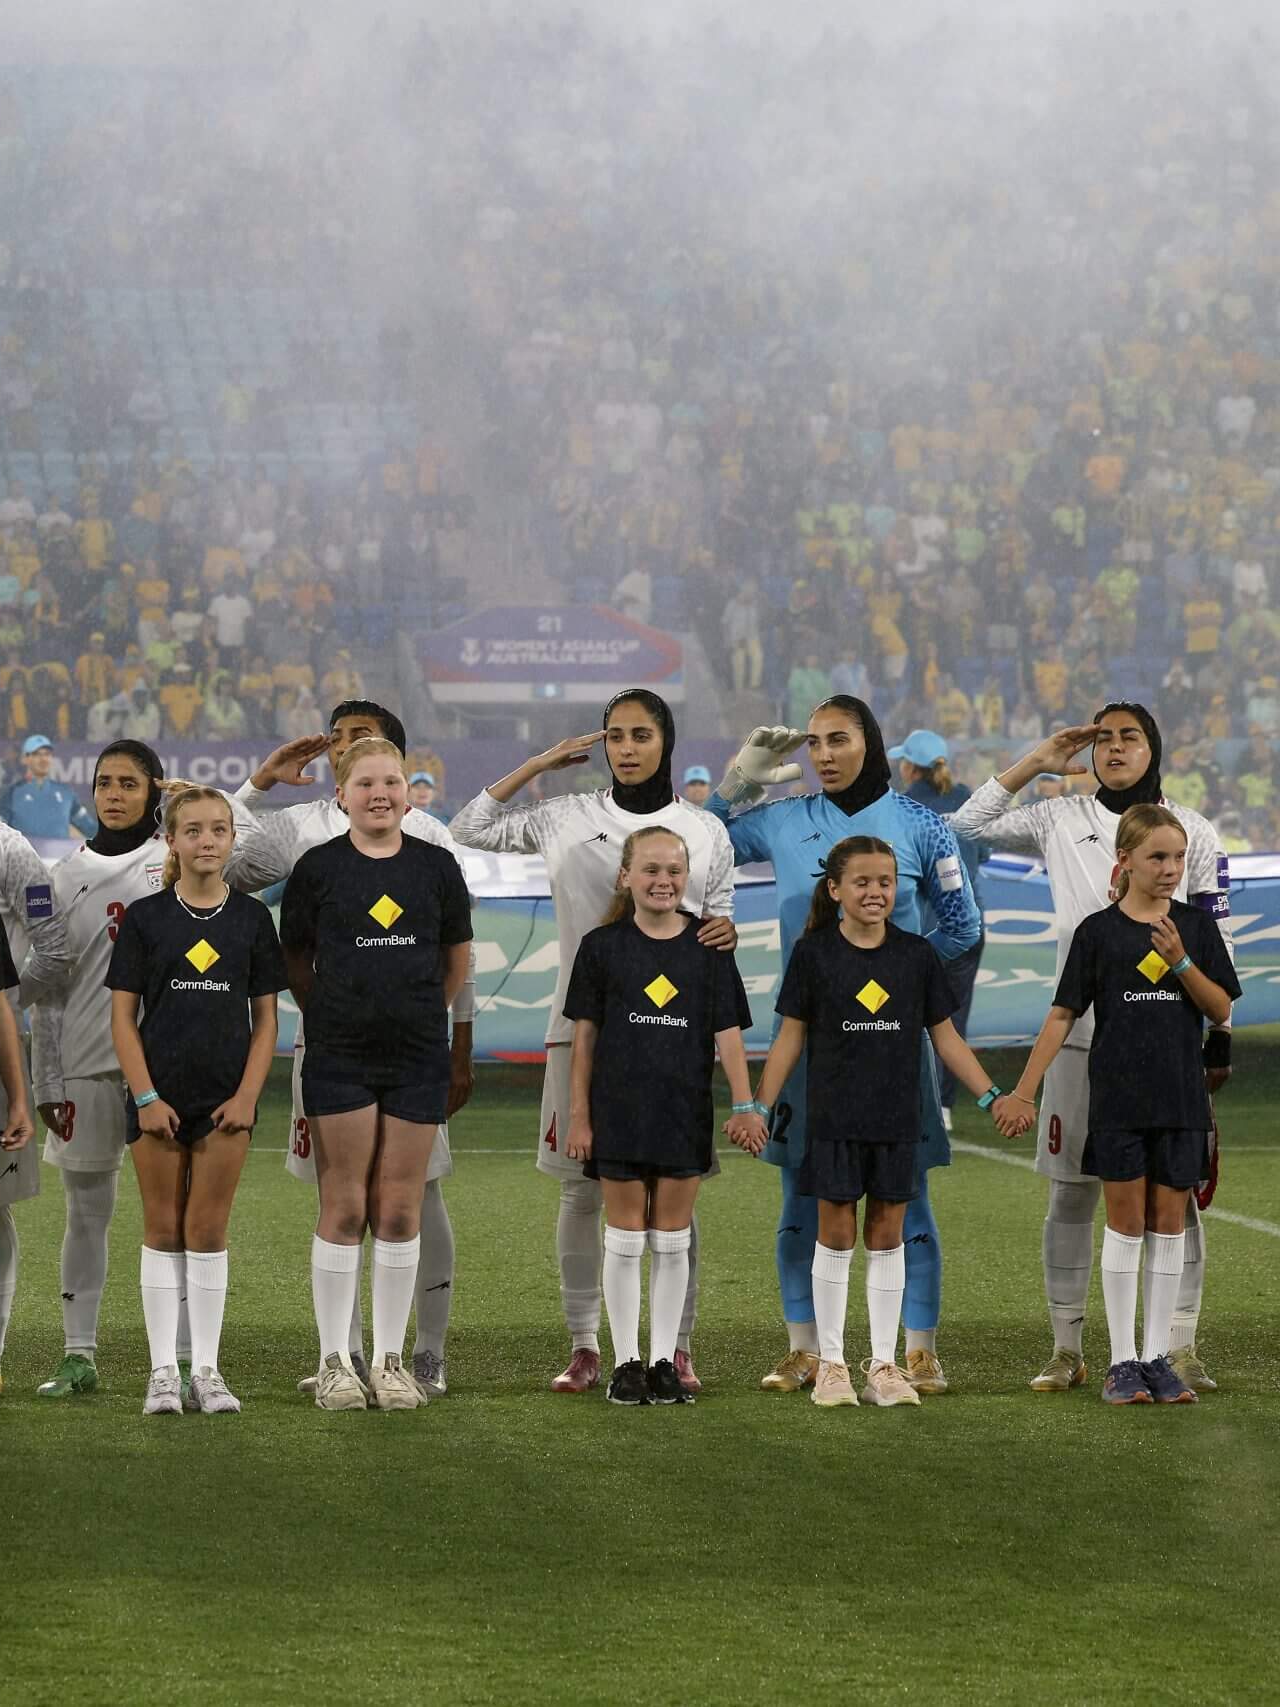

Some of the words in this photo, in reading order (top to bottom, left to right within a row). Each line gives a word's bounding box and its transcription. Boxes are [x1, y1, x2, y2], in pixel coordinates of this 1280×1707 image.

[537, 615, 562, 632] 21
[486, 653, 576, 665] AUSTRALIA
[356, 934, 417, 948] CommBank
[171, 978, 231, 992] CommBank
[1124, 989, 1182, 1002] CommBank
[629, 1012, 689, 1028] CommBank
[842, 1019, 901, 1032] CommBank
[544, 1111, 557, 1152] 4
[1048, 1113, 1062, 1156] 9
